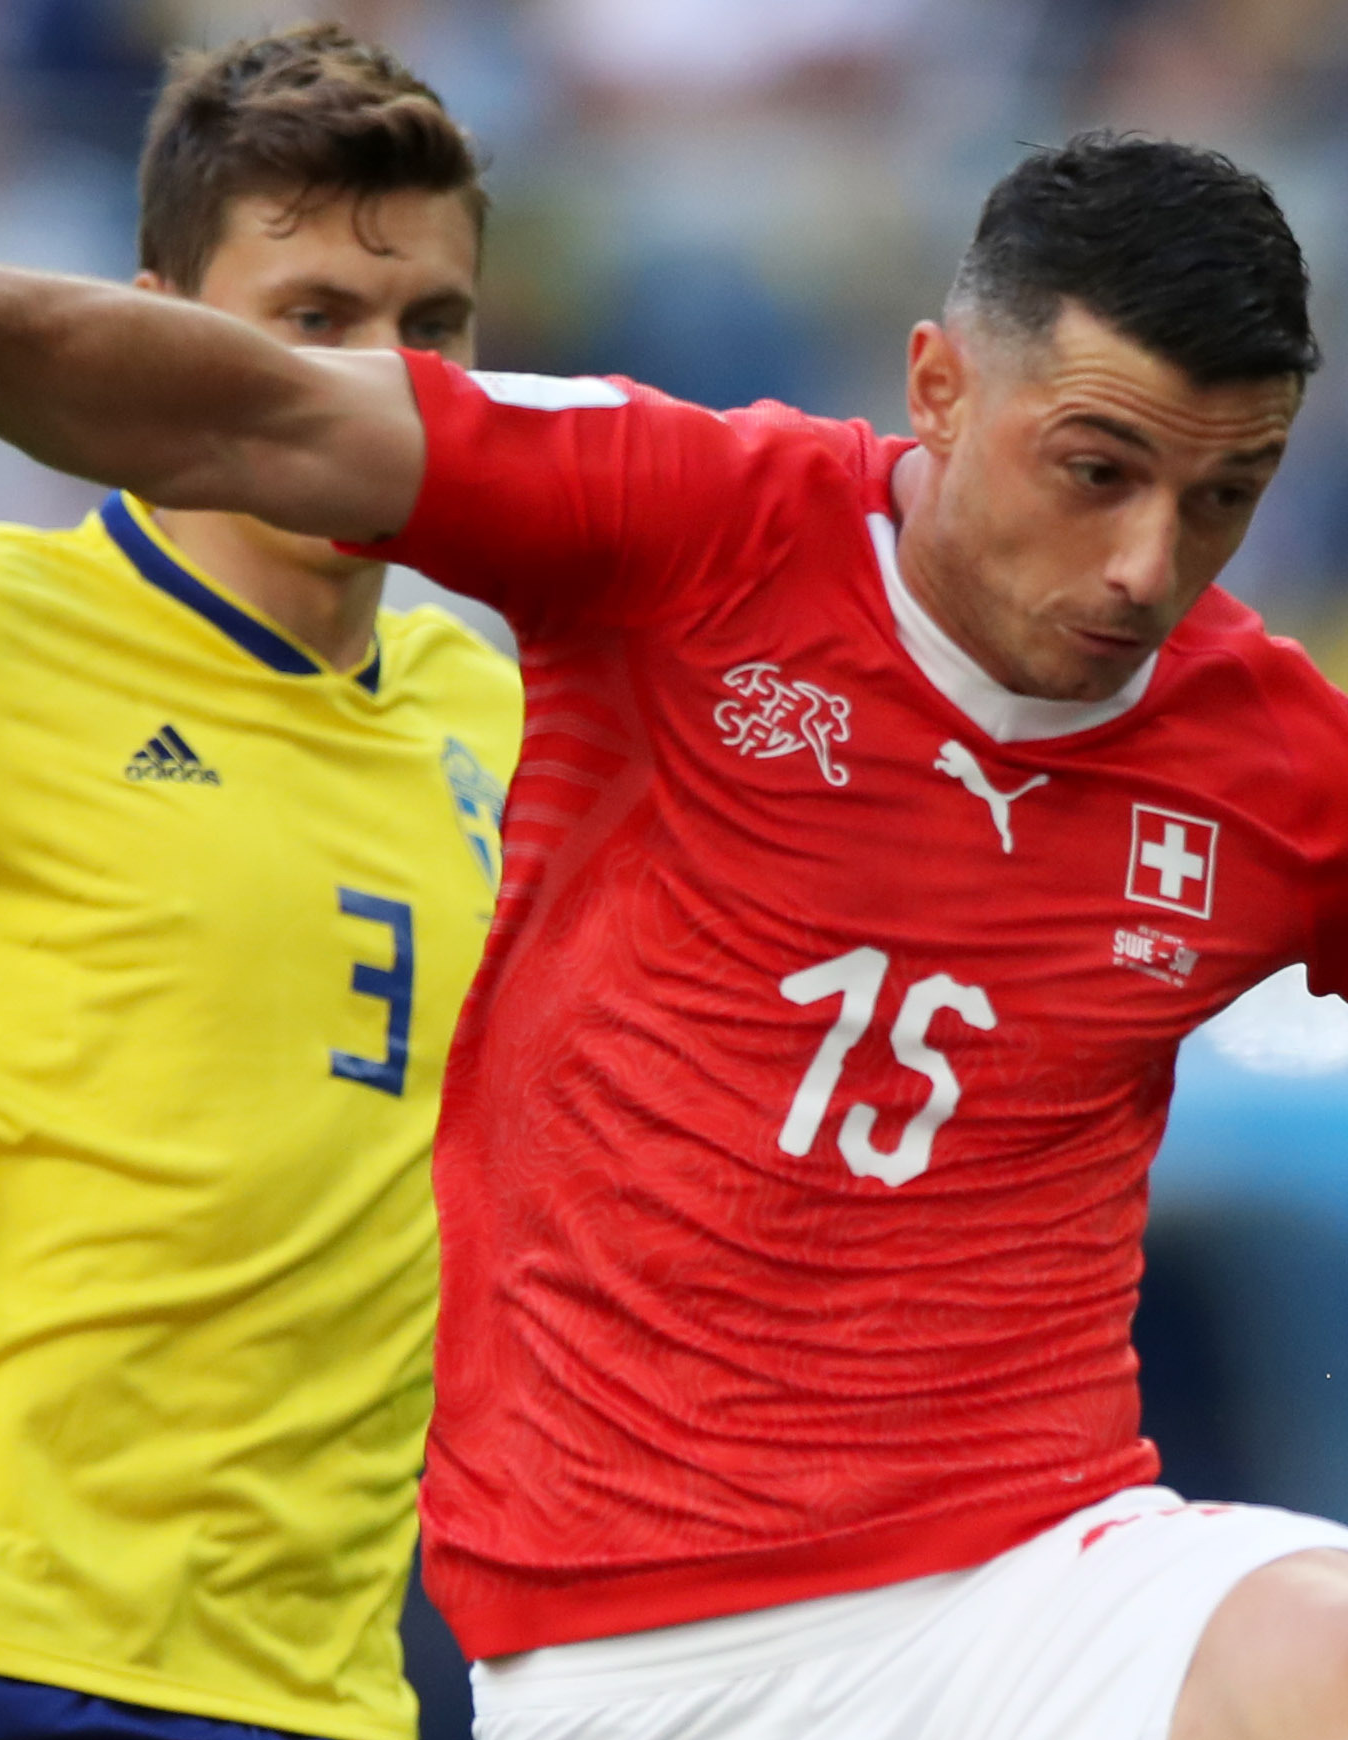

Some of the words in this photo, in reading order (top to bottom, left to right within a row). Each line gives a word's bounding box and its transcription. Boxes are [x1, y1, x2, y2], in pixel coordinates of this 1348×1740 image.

[125, 760, 221, 787] adidas
[329, 886, 414, 1099] 3
[1113, 929, 1154, 964] SWE
[778, 946, 998, 1188] 15
